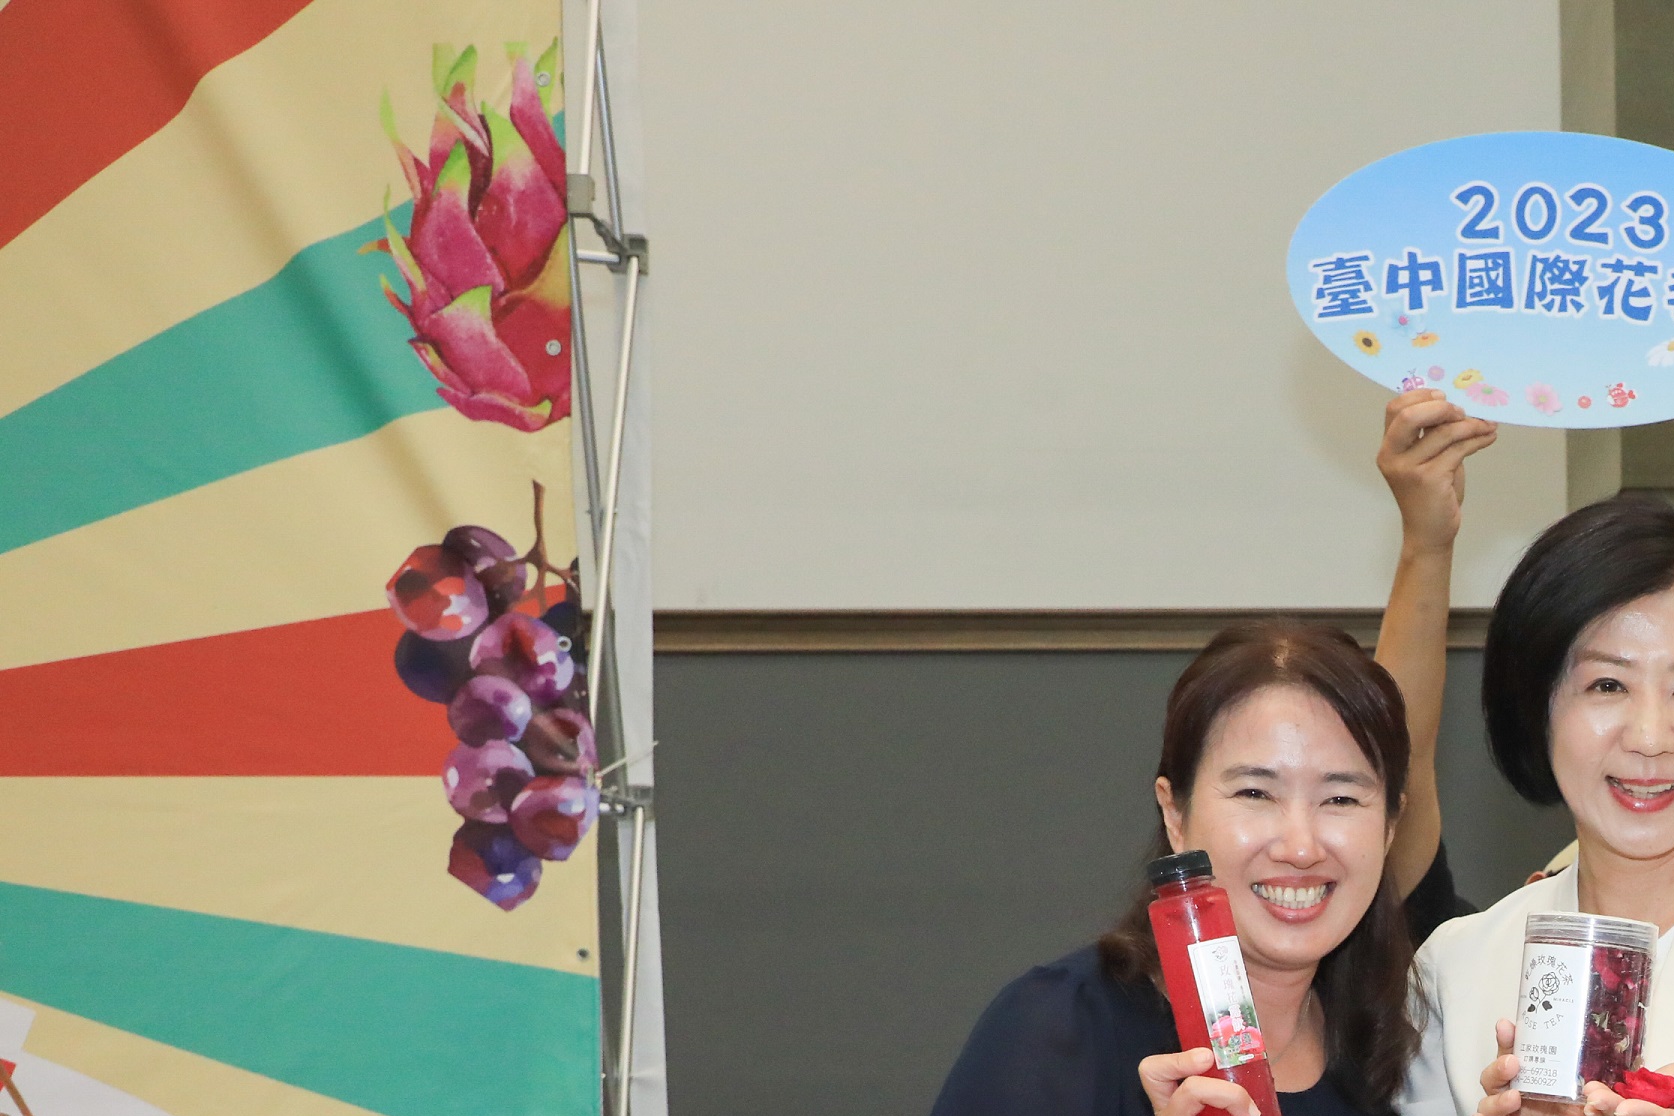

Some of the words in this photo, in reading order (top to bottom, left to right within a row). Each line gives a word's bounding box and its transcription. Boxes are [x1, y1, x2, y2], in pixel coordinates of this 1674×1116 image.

[1453, 184, 1668, 250] 2023
[1544, 1013, 1564, 1030] TEA
[1519, 1067, 1558, 1078] 86-697318
[1514, 1075, 1558, 1087] 4-25360927
